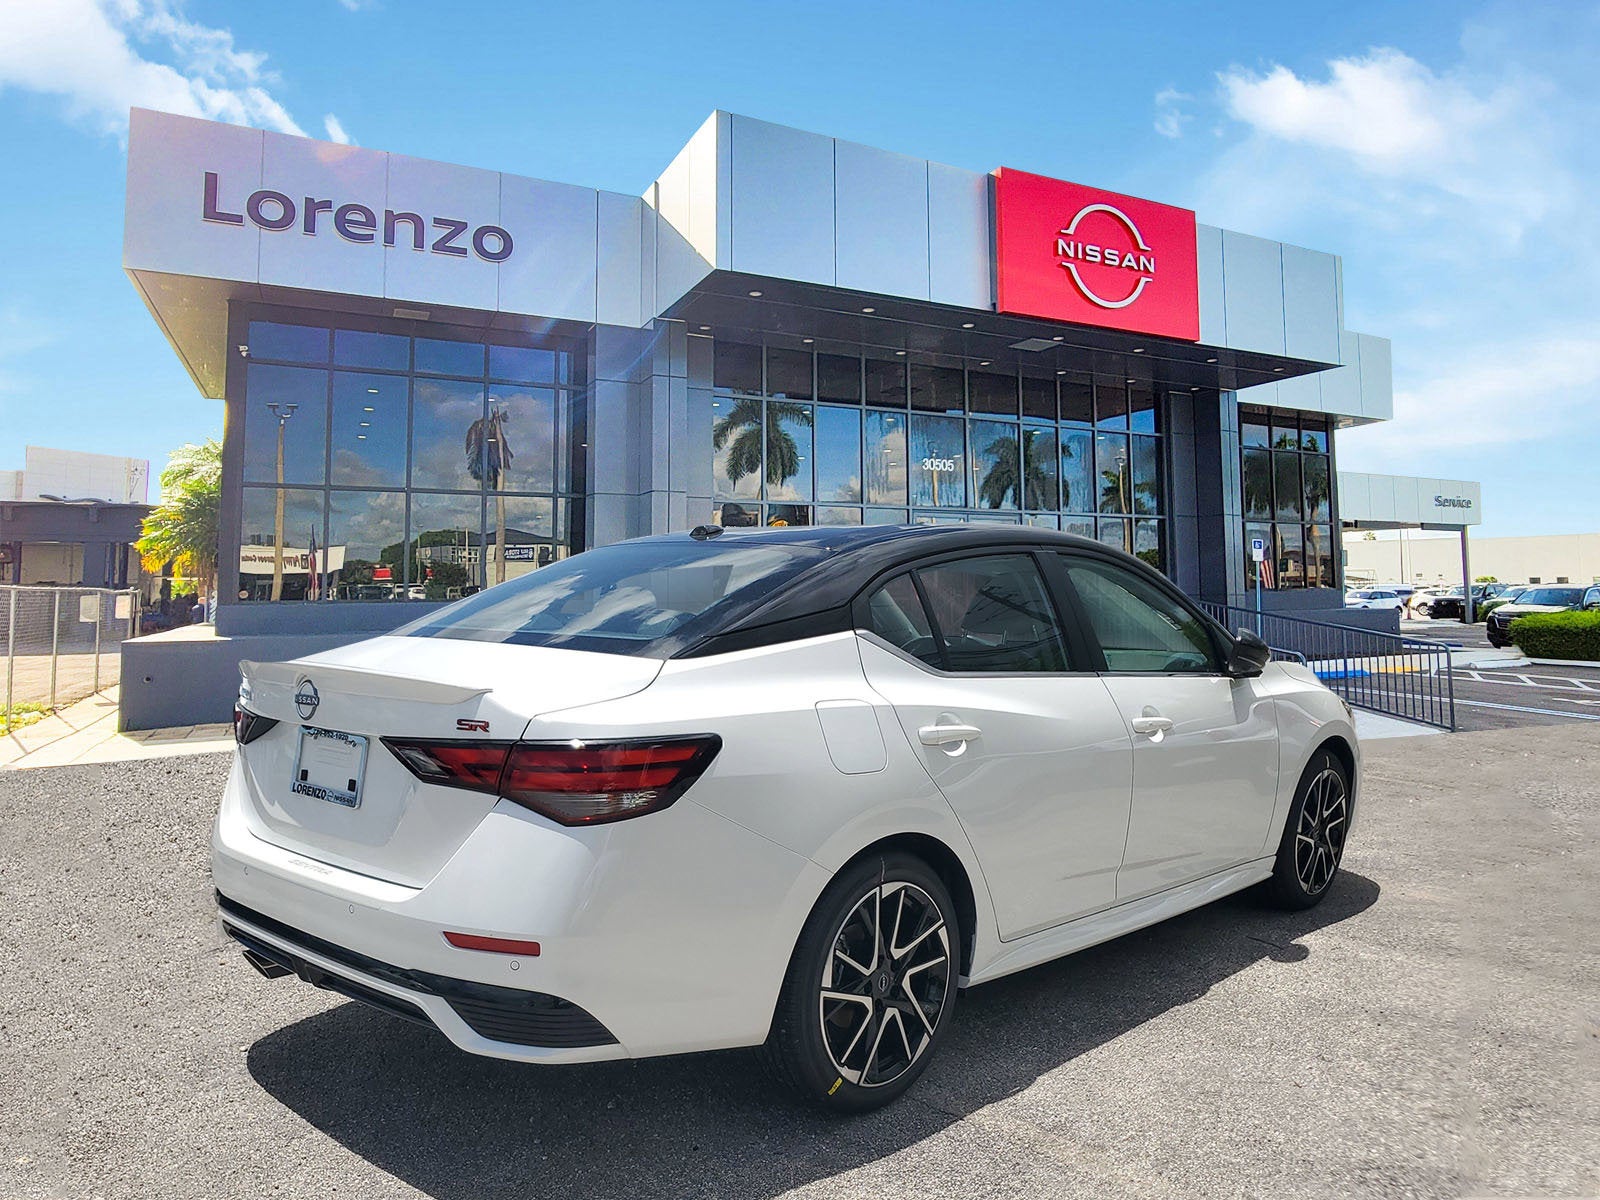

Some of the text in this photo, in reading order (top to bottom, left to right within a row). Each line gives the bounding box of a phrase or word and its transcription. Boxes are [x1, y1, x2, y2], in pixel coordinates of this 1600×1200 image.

[202, 171, 514, 262] Lorenzo
[1057, 238, 1155, 273] NISSAN
[922, 458, 954, 471] 30505
[1434, 495, 1472, 508] Service
[296, 694, 319, 706] SSAN
[456, 718, 490, 733] SR
[292, 782, 354, 805] LORENZO NISSAN
